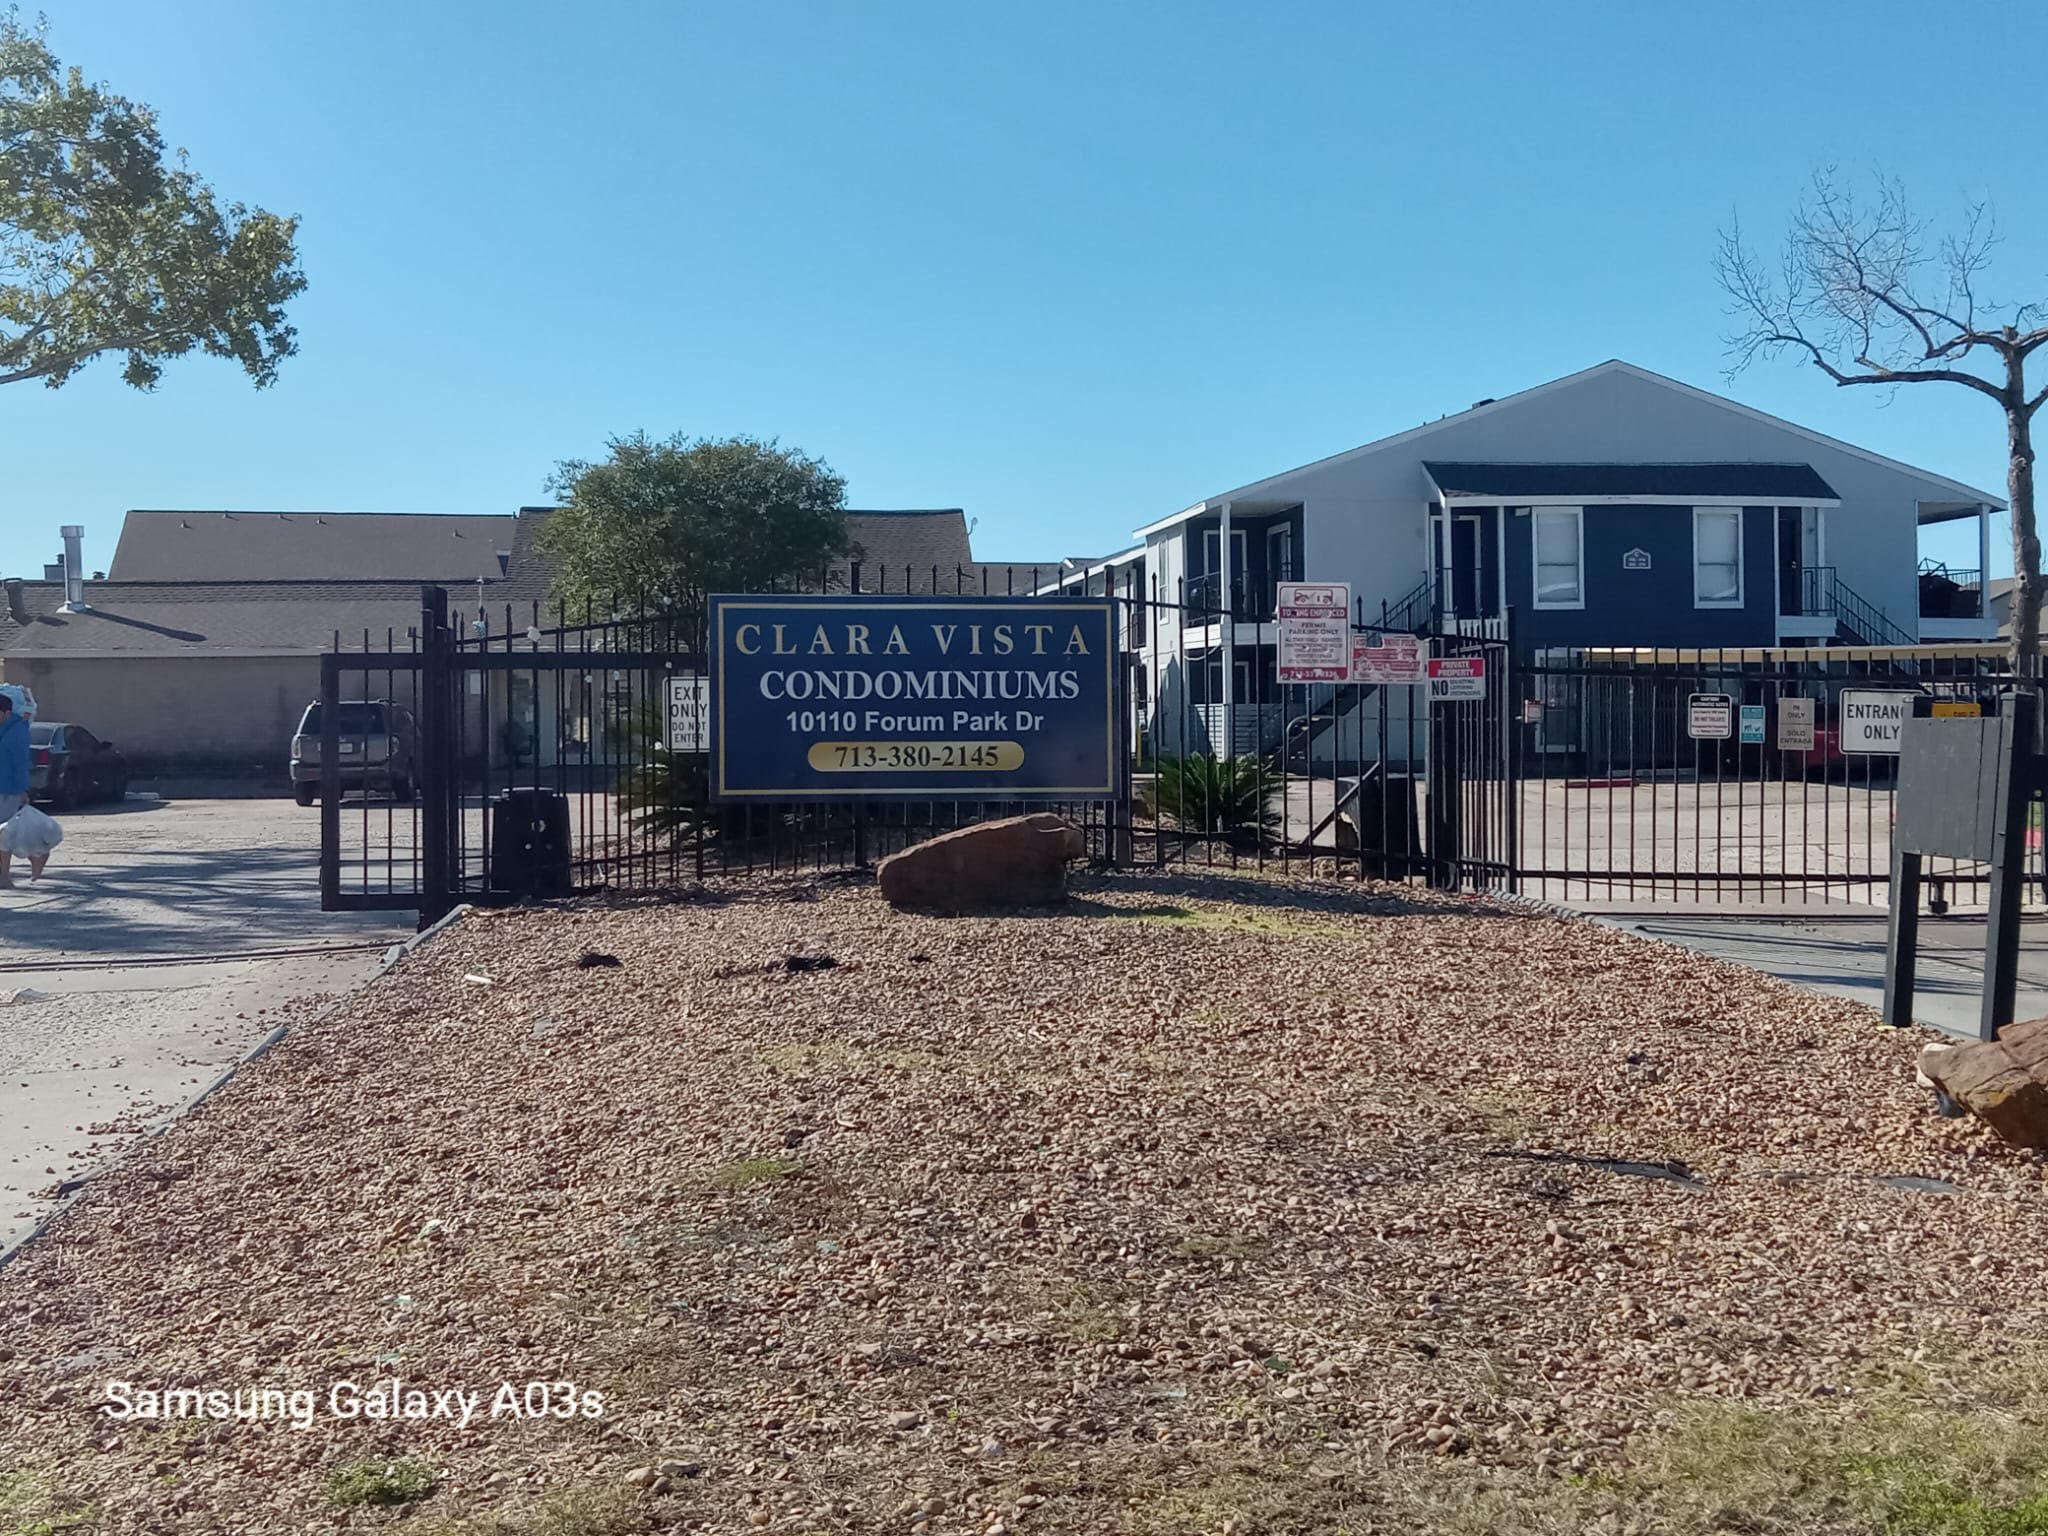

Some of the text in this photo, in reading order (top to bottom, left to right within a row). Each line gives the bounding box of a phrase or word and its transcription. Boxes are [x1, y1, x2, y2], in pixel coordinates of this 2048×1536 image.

[1282, 609, 1309, 617] TOING
[735, 624, 1091, 655] CLARA VISTA
[1441, 661, 1470, 669] PRIVATE
[1437, 669, 1475, 677] PROPERTY
[759, 670, 1081, 700] CONDOMINIUMS
[1431, 680, 1449, 696] NO
[674, 687, 704, 700] EXIT
[671, 704, 708, 718] ONLY
[1847, 704, 1903, 719] ENTRAN
[672, 722, 685, 731] DO
[786, 710, 1044, 732] 10110 Forum Park Dr
[674, 733, 704, 743] ENTER
[1864, 725, 1900, 740] ONLY
[834, 745, 999, 768] 713-380-2145
